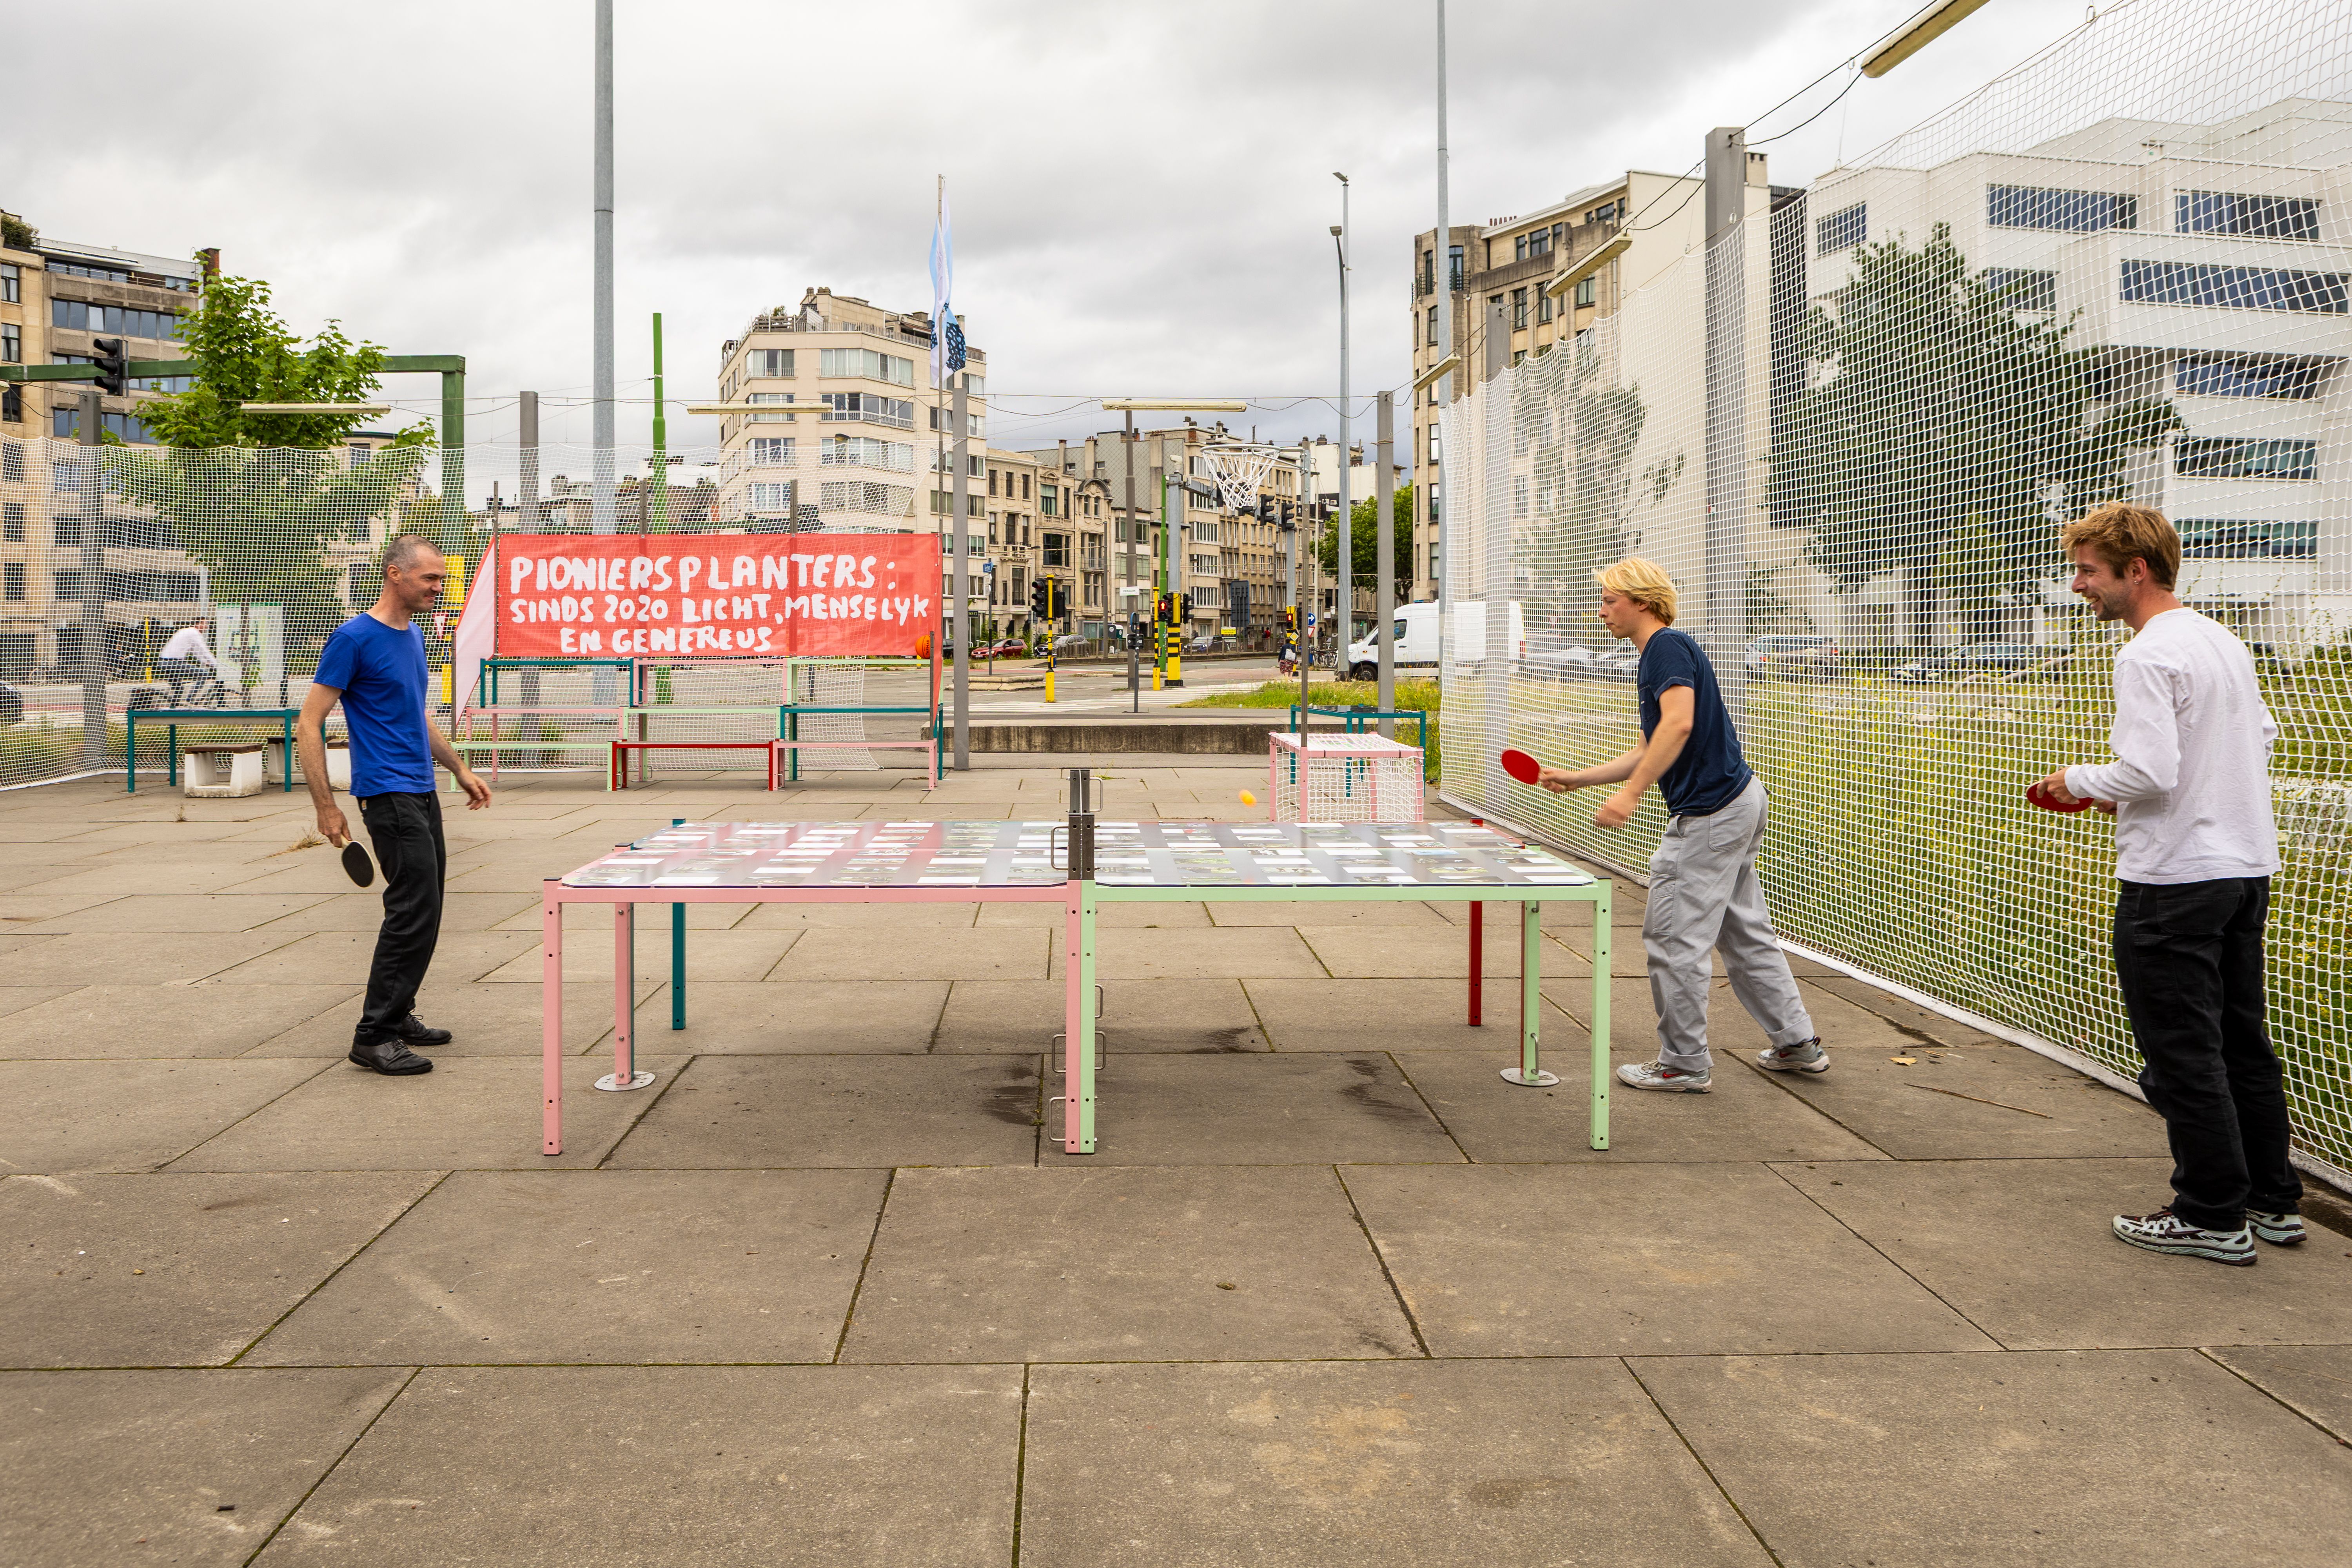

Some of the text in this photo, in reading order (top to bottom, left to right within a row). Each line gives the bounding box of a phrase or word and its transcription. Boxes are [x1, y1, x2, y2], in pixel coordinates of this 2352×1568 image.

[510, 596, 594, 623] SINDS
[604, 594, 668, 622] 2020
[682, 593, 784, 624] LICHT,
[560, 625, 773, 654] EN GENEREUS
